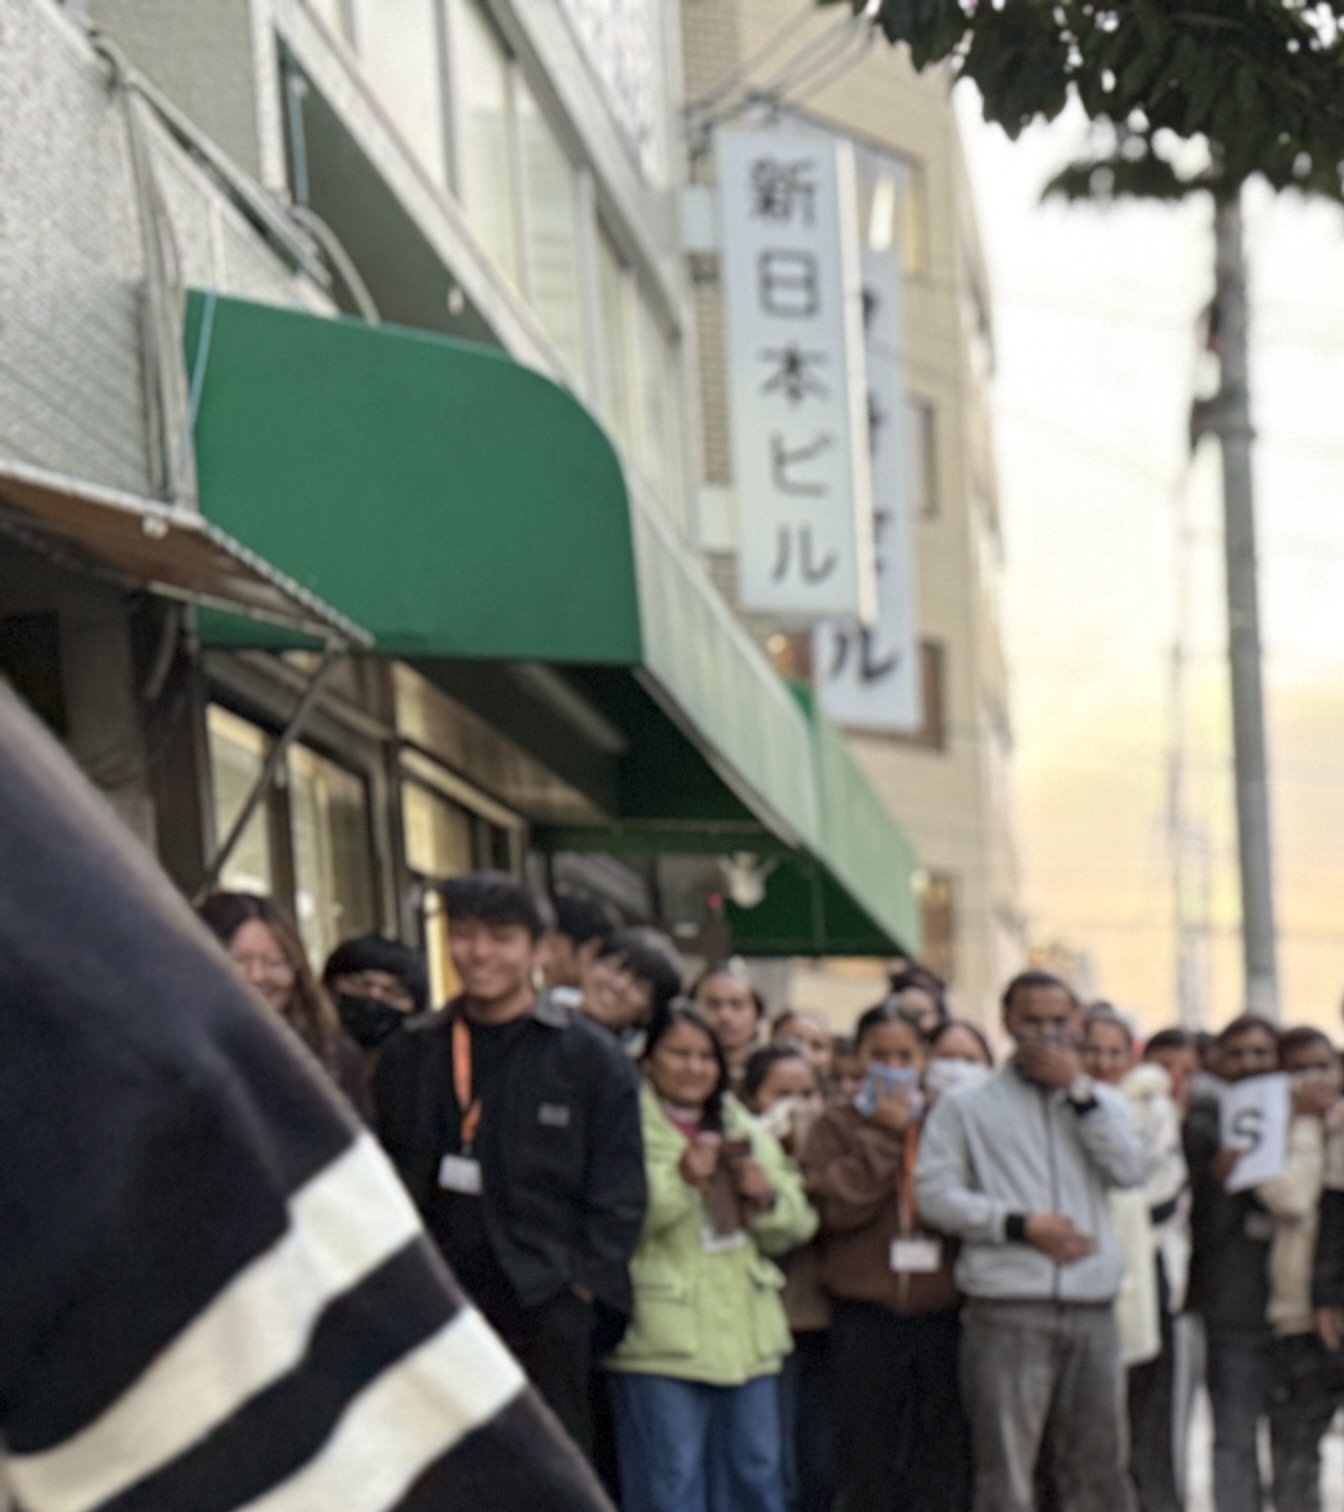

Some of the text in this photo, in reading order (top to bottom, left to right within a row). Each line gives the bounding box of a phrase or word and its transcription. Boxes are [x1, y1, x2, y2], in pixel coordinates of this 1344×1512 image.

[749, 156, 838, 585] 新日本ビル
[1231, 1107, 1267, 1156] S
